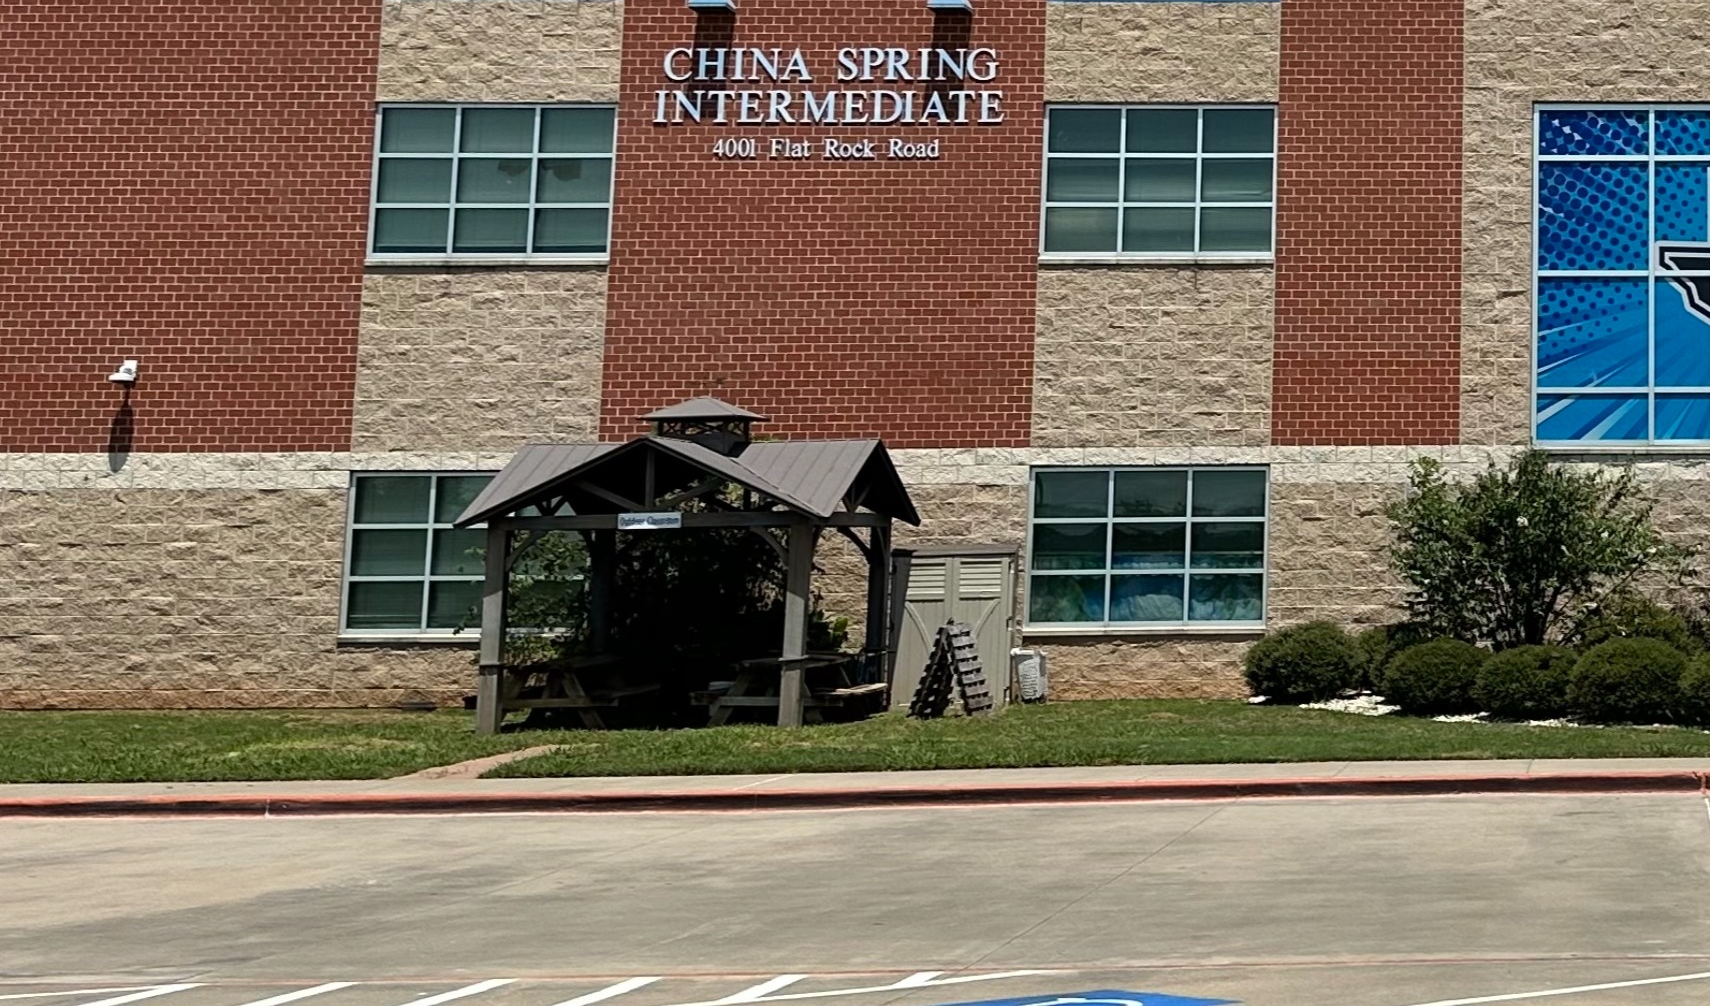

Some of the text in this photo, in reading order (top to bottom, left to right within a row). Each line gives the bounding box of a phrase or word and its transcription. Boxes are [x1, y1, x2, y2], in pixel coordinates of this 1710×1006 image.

[662, 47, 1000, 82] CHINA SPRING
[652, 89, 1005, 125] INTERMEDIATE
[711, 137, 940, 159] 4001 Flat Rock Road
